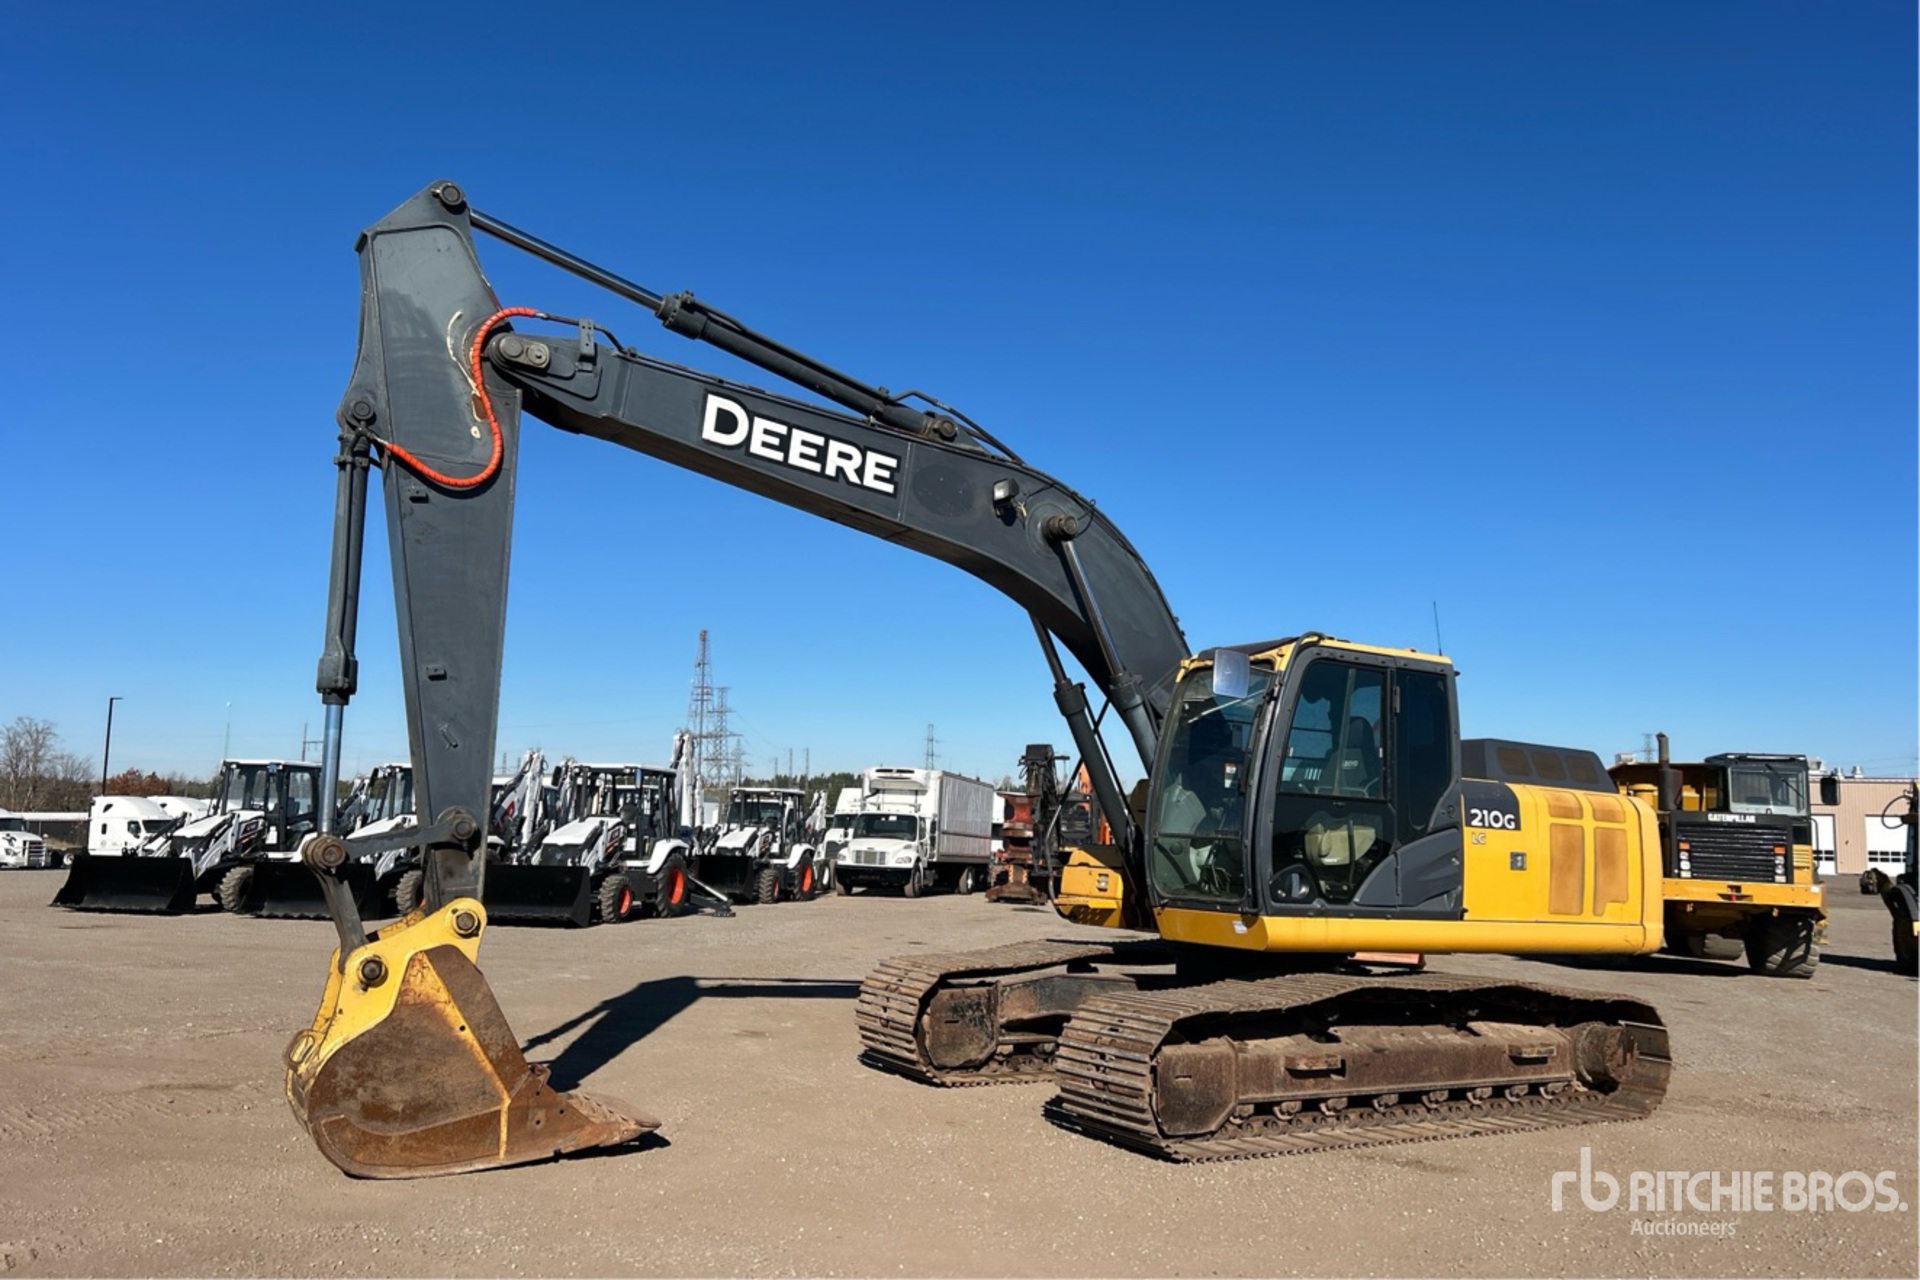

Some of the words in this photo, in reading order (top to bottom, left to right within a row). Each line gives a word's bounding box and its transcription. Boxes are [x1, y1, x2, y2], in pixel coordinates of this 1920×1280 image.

[702, 393, 898, 495] DEERE
[1470, 808, 1516, 830] 210G
[1707, 812, 1757, 824] CATERPILLAR
[1471, 832, 1487, 845] LC
